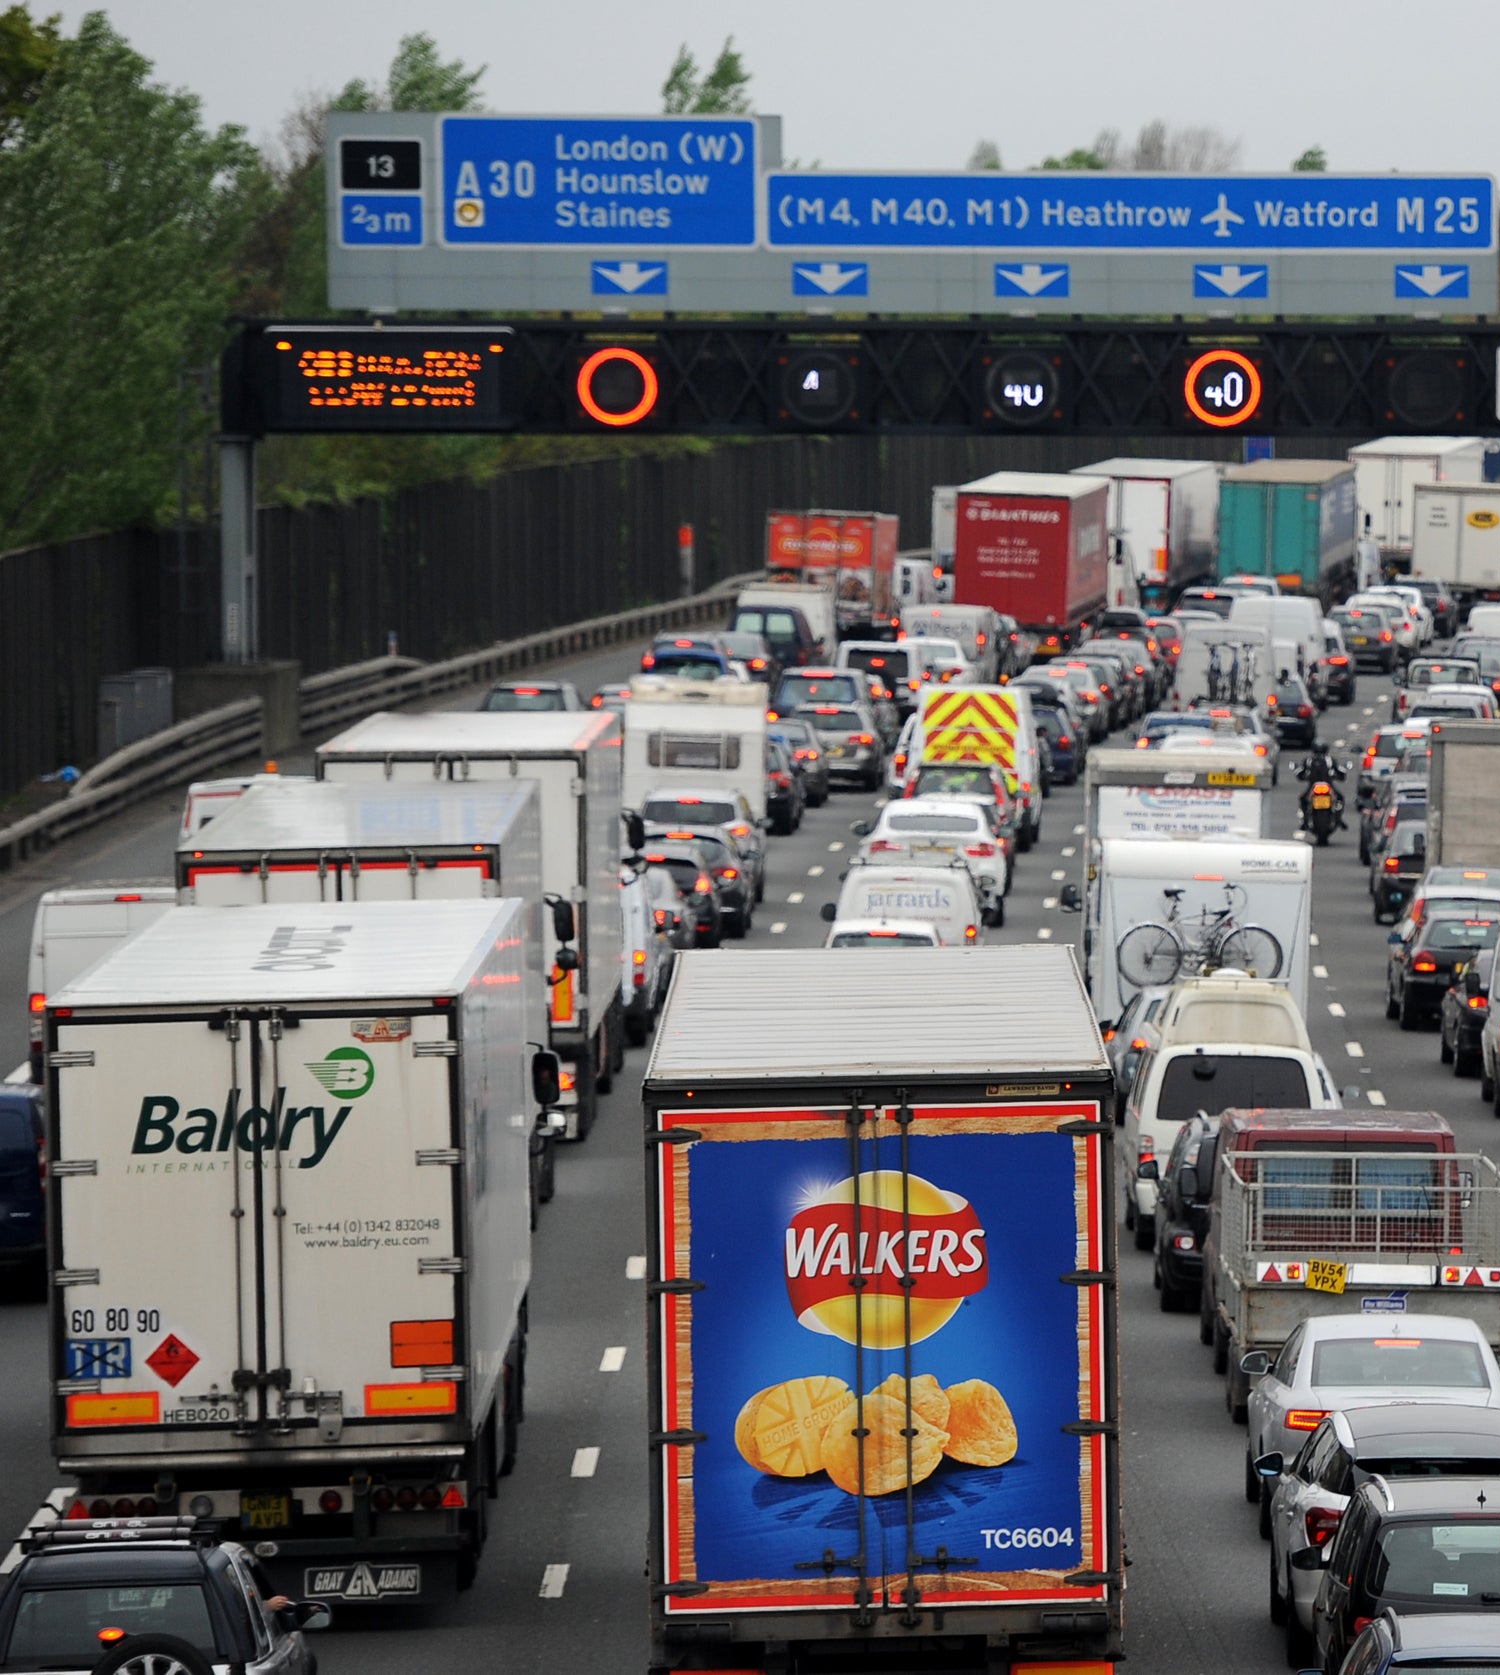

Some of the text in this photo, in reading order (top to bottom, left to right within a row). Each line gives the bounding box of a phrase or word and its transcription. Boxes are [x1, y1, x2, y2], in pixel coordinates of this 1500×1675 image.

[555, 131, 744, 166] London (W)
[366, 155, 396, 178] 13
[555, 167, 709, 195] Hounslow
[555, 200, 671, 229] Staines
[1041, 199, 1191, 229] Heathrow
[1254, 199, 1379, 229] Watford
[1205, 371, 1244, 409] 40
[866, 889, 951, 913] jarrards
[131, 1086, 352, 1169] Baldry
[126, 1160, 299, 1174] INTERNATONL
[292, 1218, 440, 1235] Tel: +44 (0) 1342 832048
[304, 1235, 430, 1250] www.baldry.eu.com
[785, 1222, 987, 1280] WALKERS
[1311, 1261, 1345, 1277] BV54
[1314, 1275, 1339, 1291] YPX
[71, 1308, 160, 1333] 60 80 90
[70, 1341, 127, 1377] TIR
[163, 1407, 230, 1423] HEB020
[763, 1421, 801, 1447] HOME
[981, 1526, 1075, 1550] TC6604
[313, 1571, 344, 1592] GRAY
[377, 1568, 418, 1590] ADAMS
